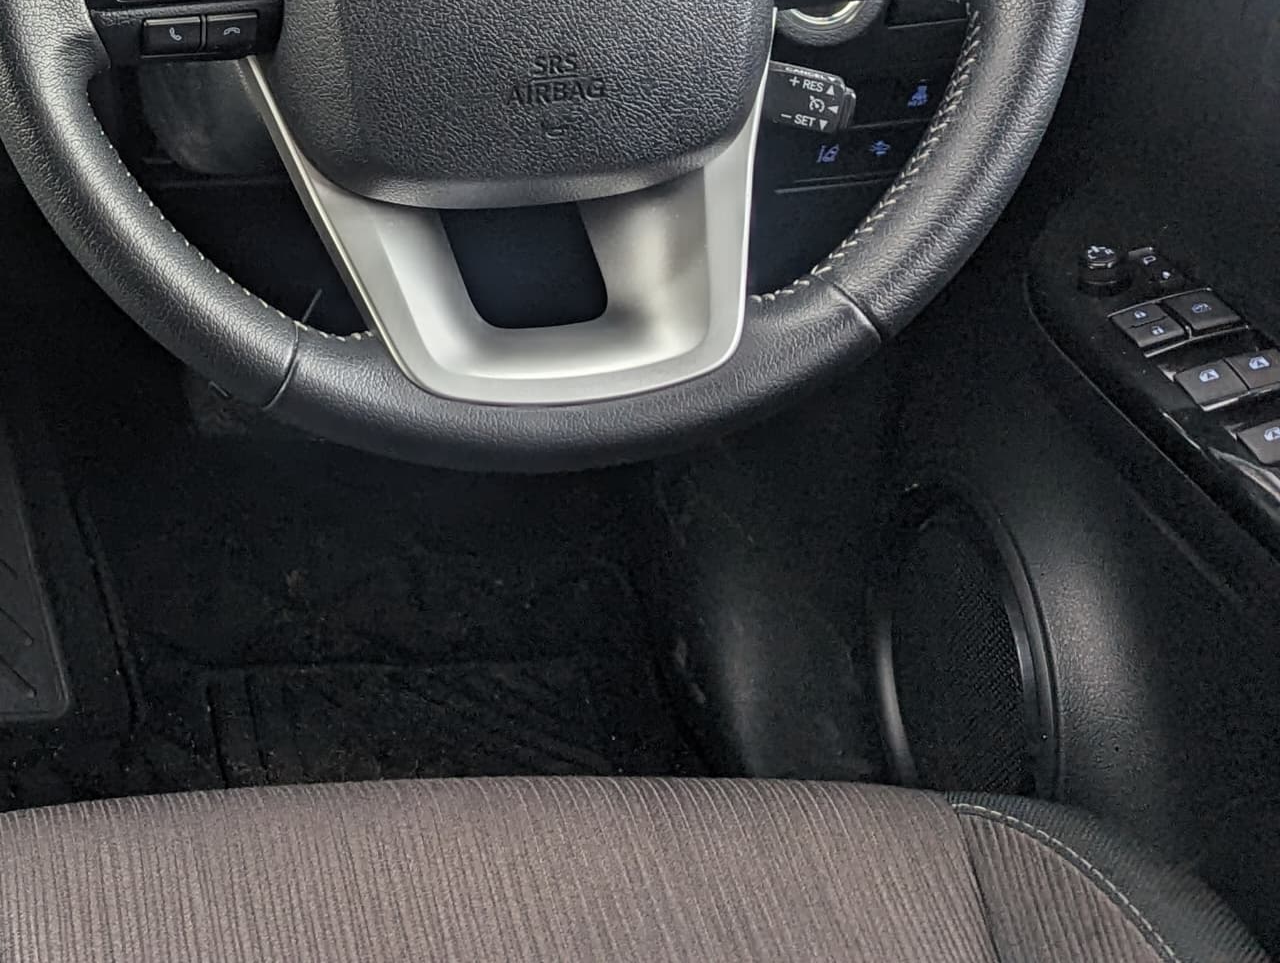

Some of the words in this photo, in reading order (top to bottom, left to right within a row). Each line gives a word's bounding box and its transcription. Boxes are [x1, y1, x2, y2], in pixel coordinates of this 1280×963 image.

[534, 54, 577, 76] SRS
[507, 78, 606, 106] AIRBAG
[802, 79, 825, 93] RES
[794, 113, 816, 127] SET
